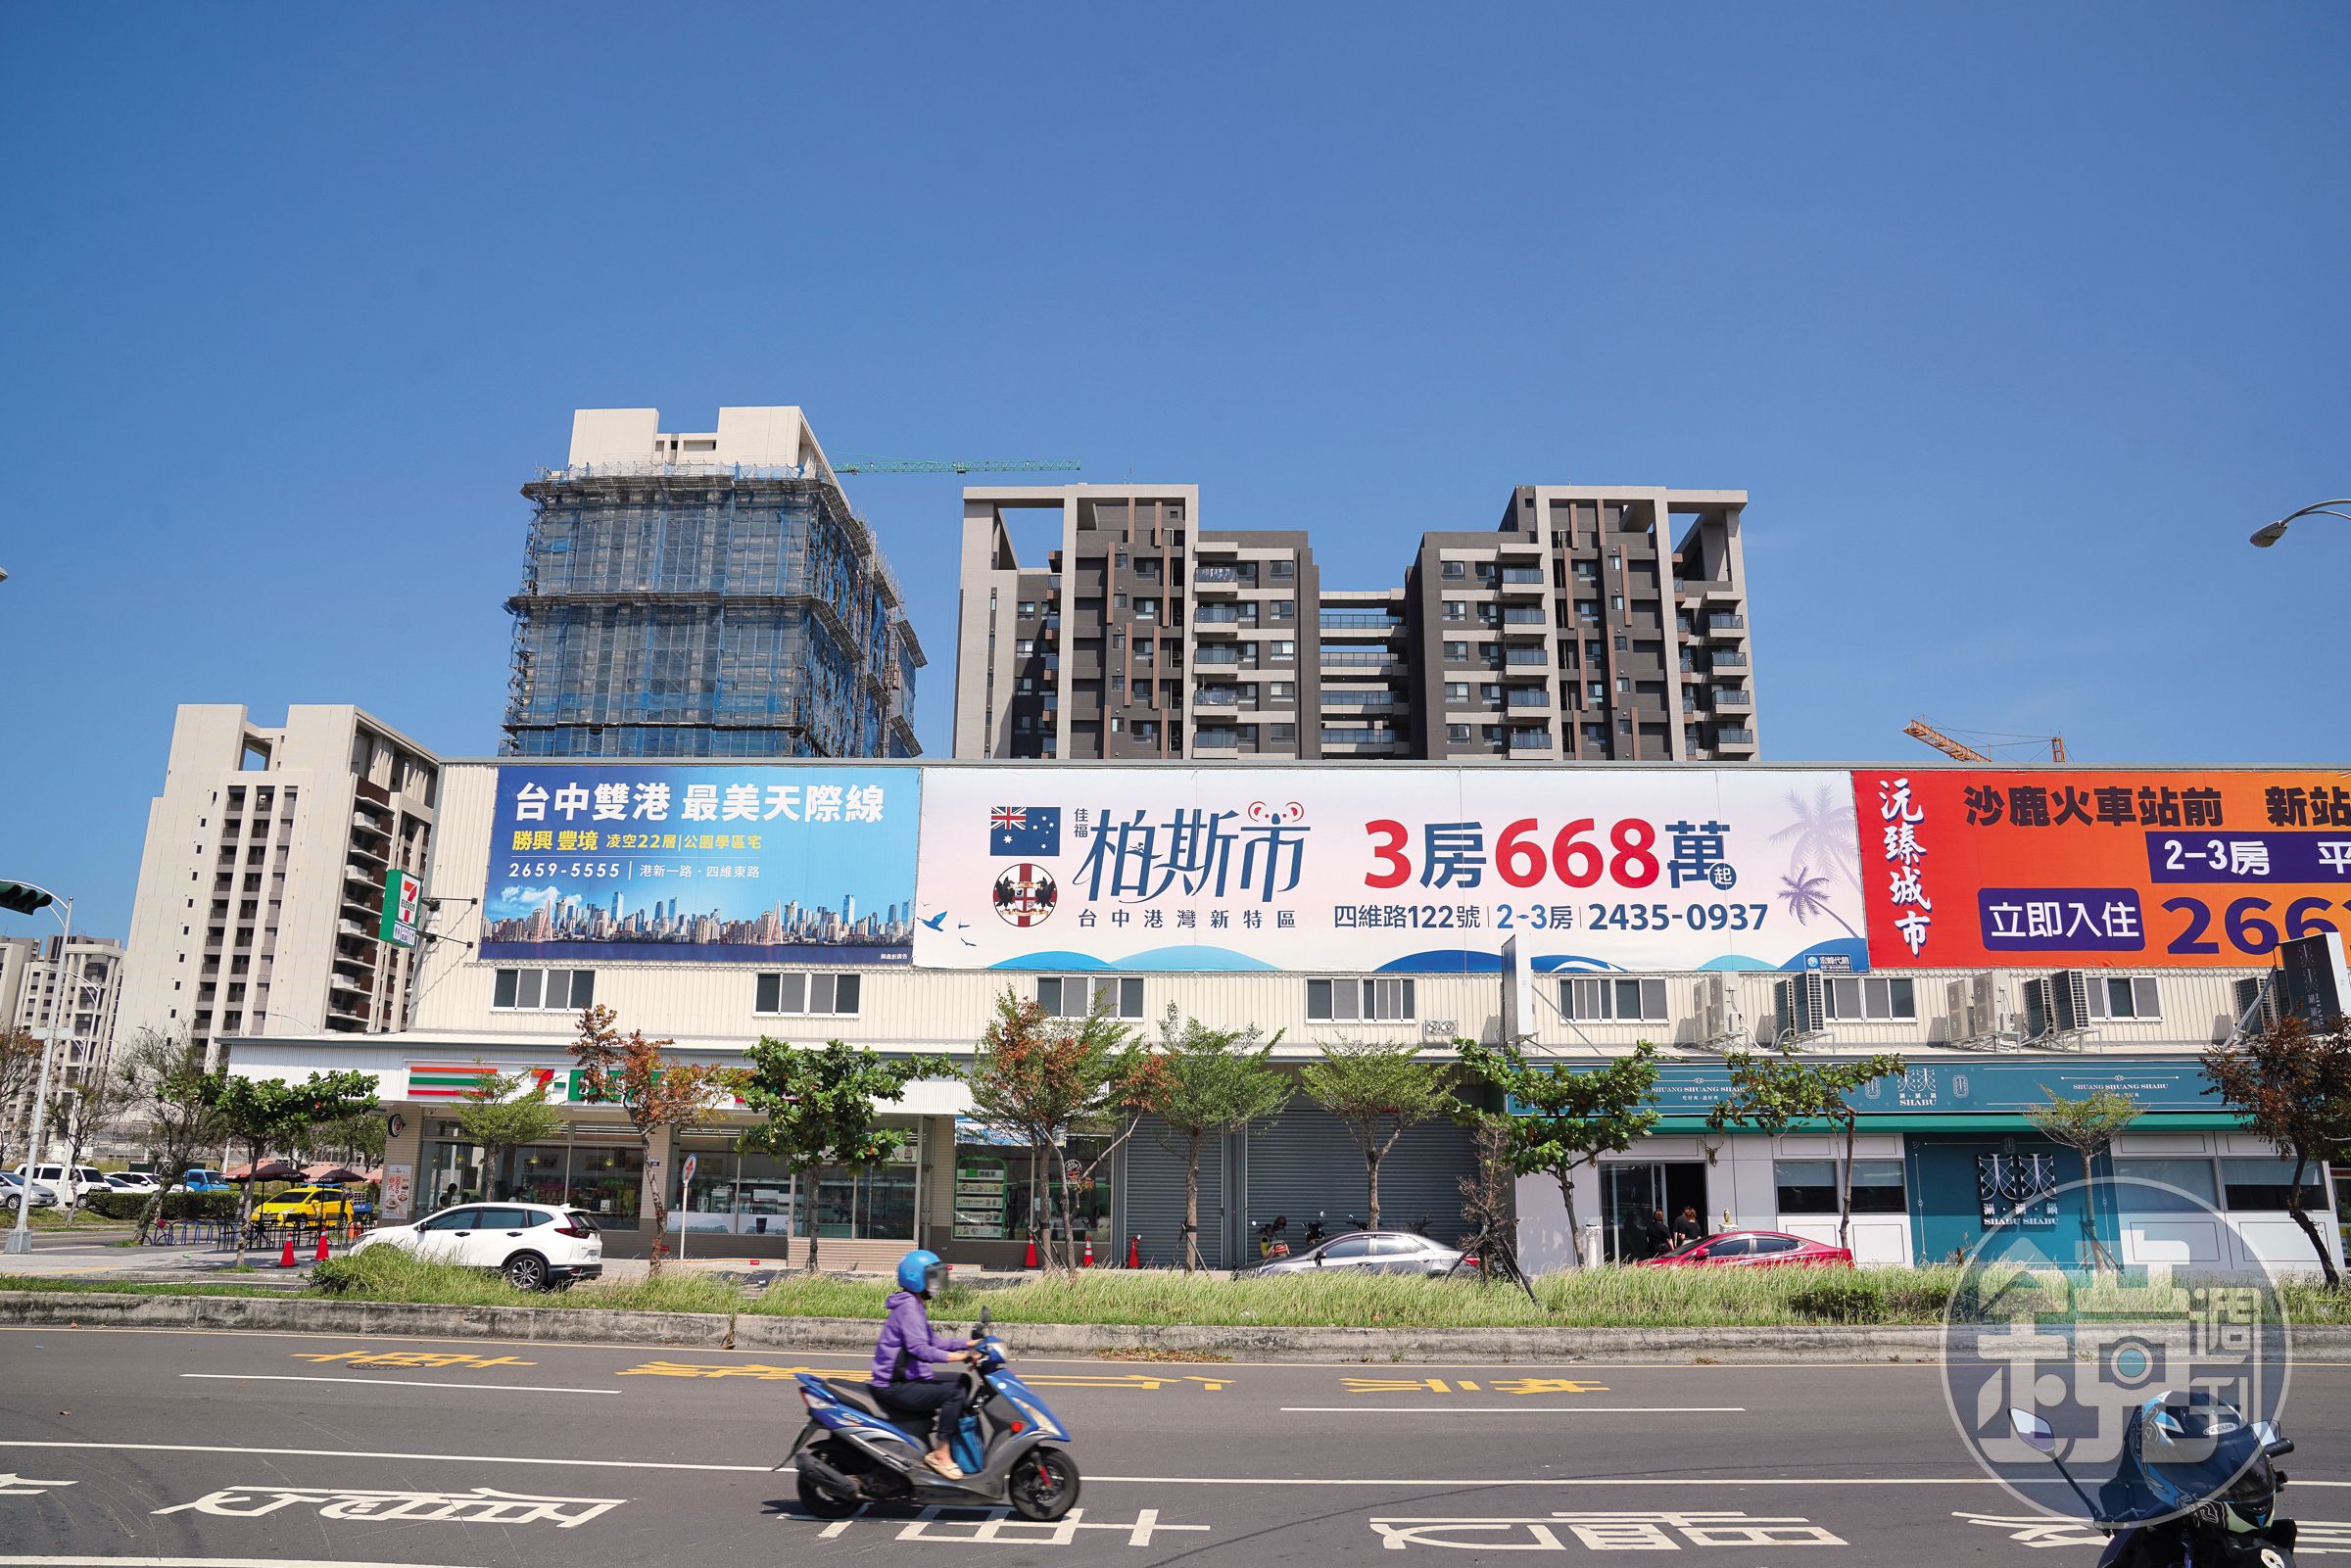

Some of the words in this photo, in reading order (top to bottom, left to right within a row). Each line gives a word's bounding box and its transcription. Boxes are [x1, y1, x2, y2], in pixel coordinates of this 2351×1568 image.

[515, 782, 671, 822] 台中雙港
[680, 784, 886, 824] 最美天際線
[1963, 785, 2224, 828] 沙鹿火車站前
[2265, 785, 2351, 828] 新站
[511, 831, 553, 851] 勝興
[557, 832, 600, 851] 豐境
[605, 833, 677, 850] 凌空22層
[684, 834, 762, 850] 公園學區宅
[1074, 807, 1089, 839] 佳福
[508, 863, 620, 879] 2659-5555
[639, 864, 693, 879] 港新一路
[706, 865, 760, 879] 四維東路
[1073, 808, 1312, 903] 柏斯市
[1878, 778, 1933, 957] 沅臻城市
[2166, 839, 2271, 876] 2-3房
[2317, 841, 2351, 875] 平
[1079, 909, 1297, 929] 台中港灣新特區
[1333, 904, 1481, 929] 四維路122號
[1497, 904, 1573, 929] 2-3房
[1589, 904, 1768, 930] 2435-0937
[1988, 901, 2140, 938] 立即入住
[2161, 896, 2351, 956] 266
